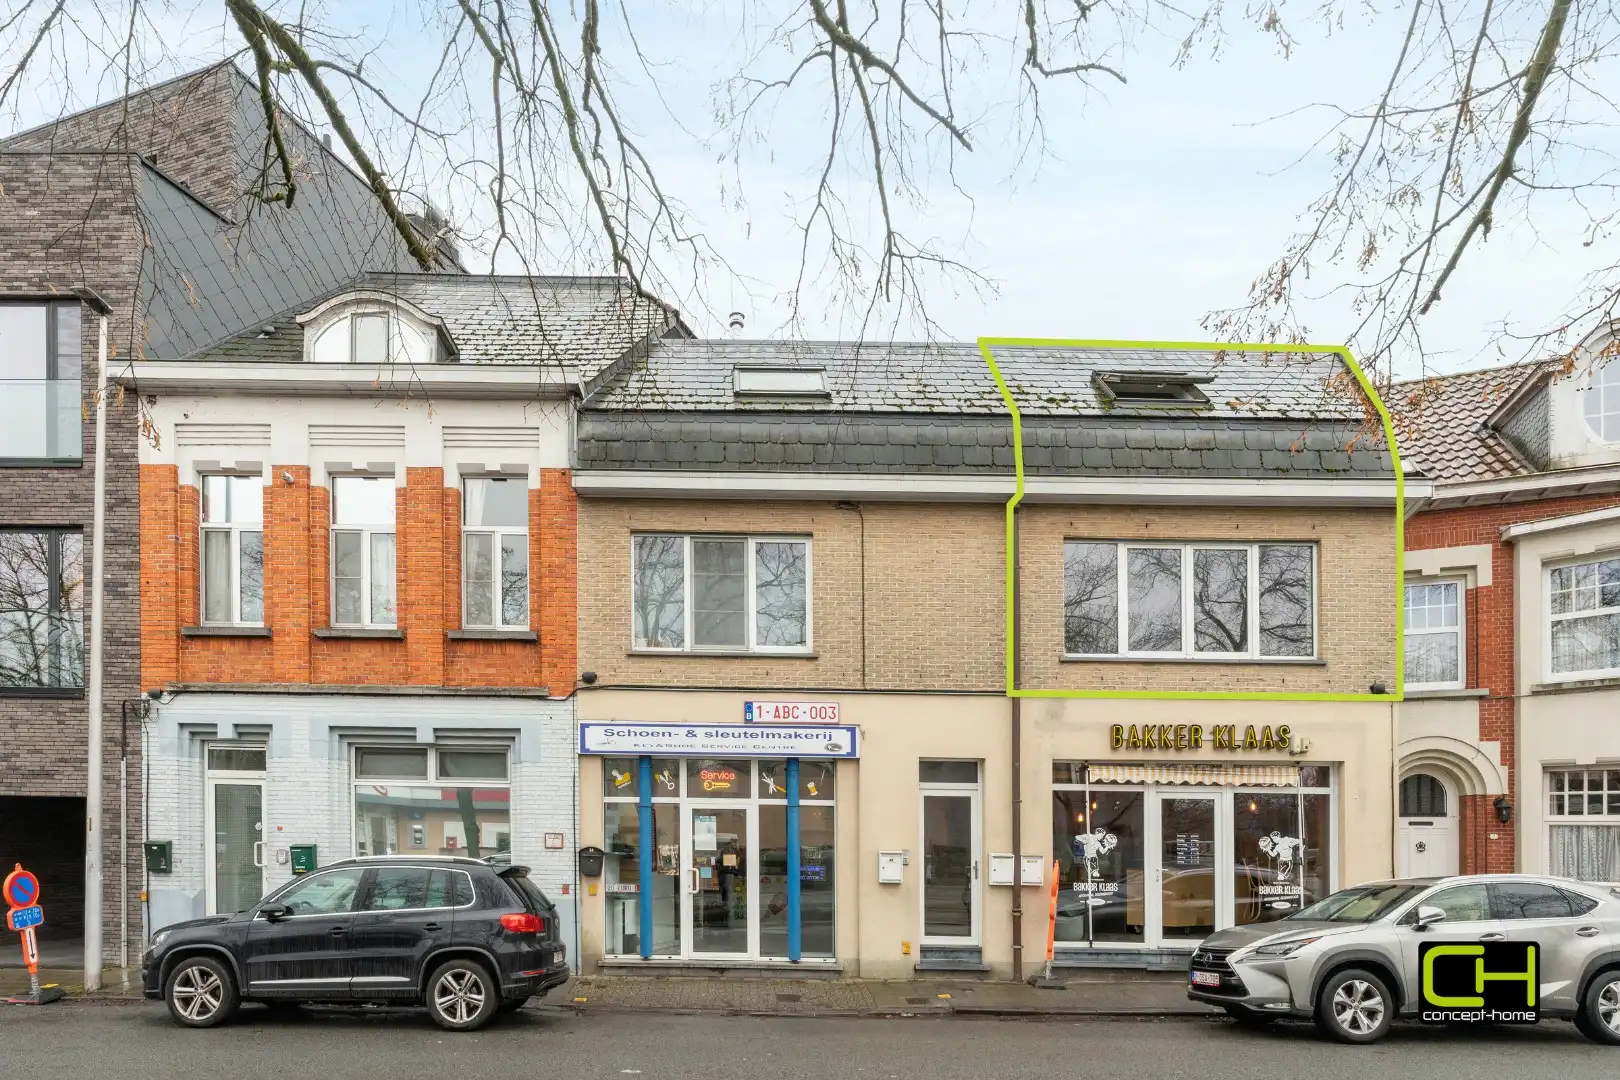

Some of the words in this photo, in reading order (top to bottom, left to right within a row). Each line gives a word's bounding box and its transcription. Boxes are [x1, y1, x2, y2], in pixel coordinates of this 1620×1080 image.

[746, 712, 752, 720] B
[604, 728, 679, 738] Schoen-
[685, 729, 698, 738] &
[704, 729, 832, 741] sleutelmakerij
[1111, 724, 1203, 749] BAKKER
[1213, 724, 1291, 749] KLAAS
[701, 769, 735, 780] Service
